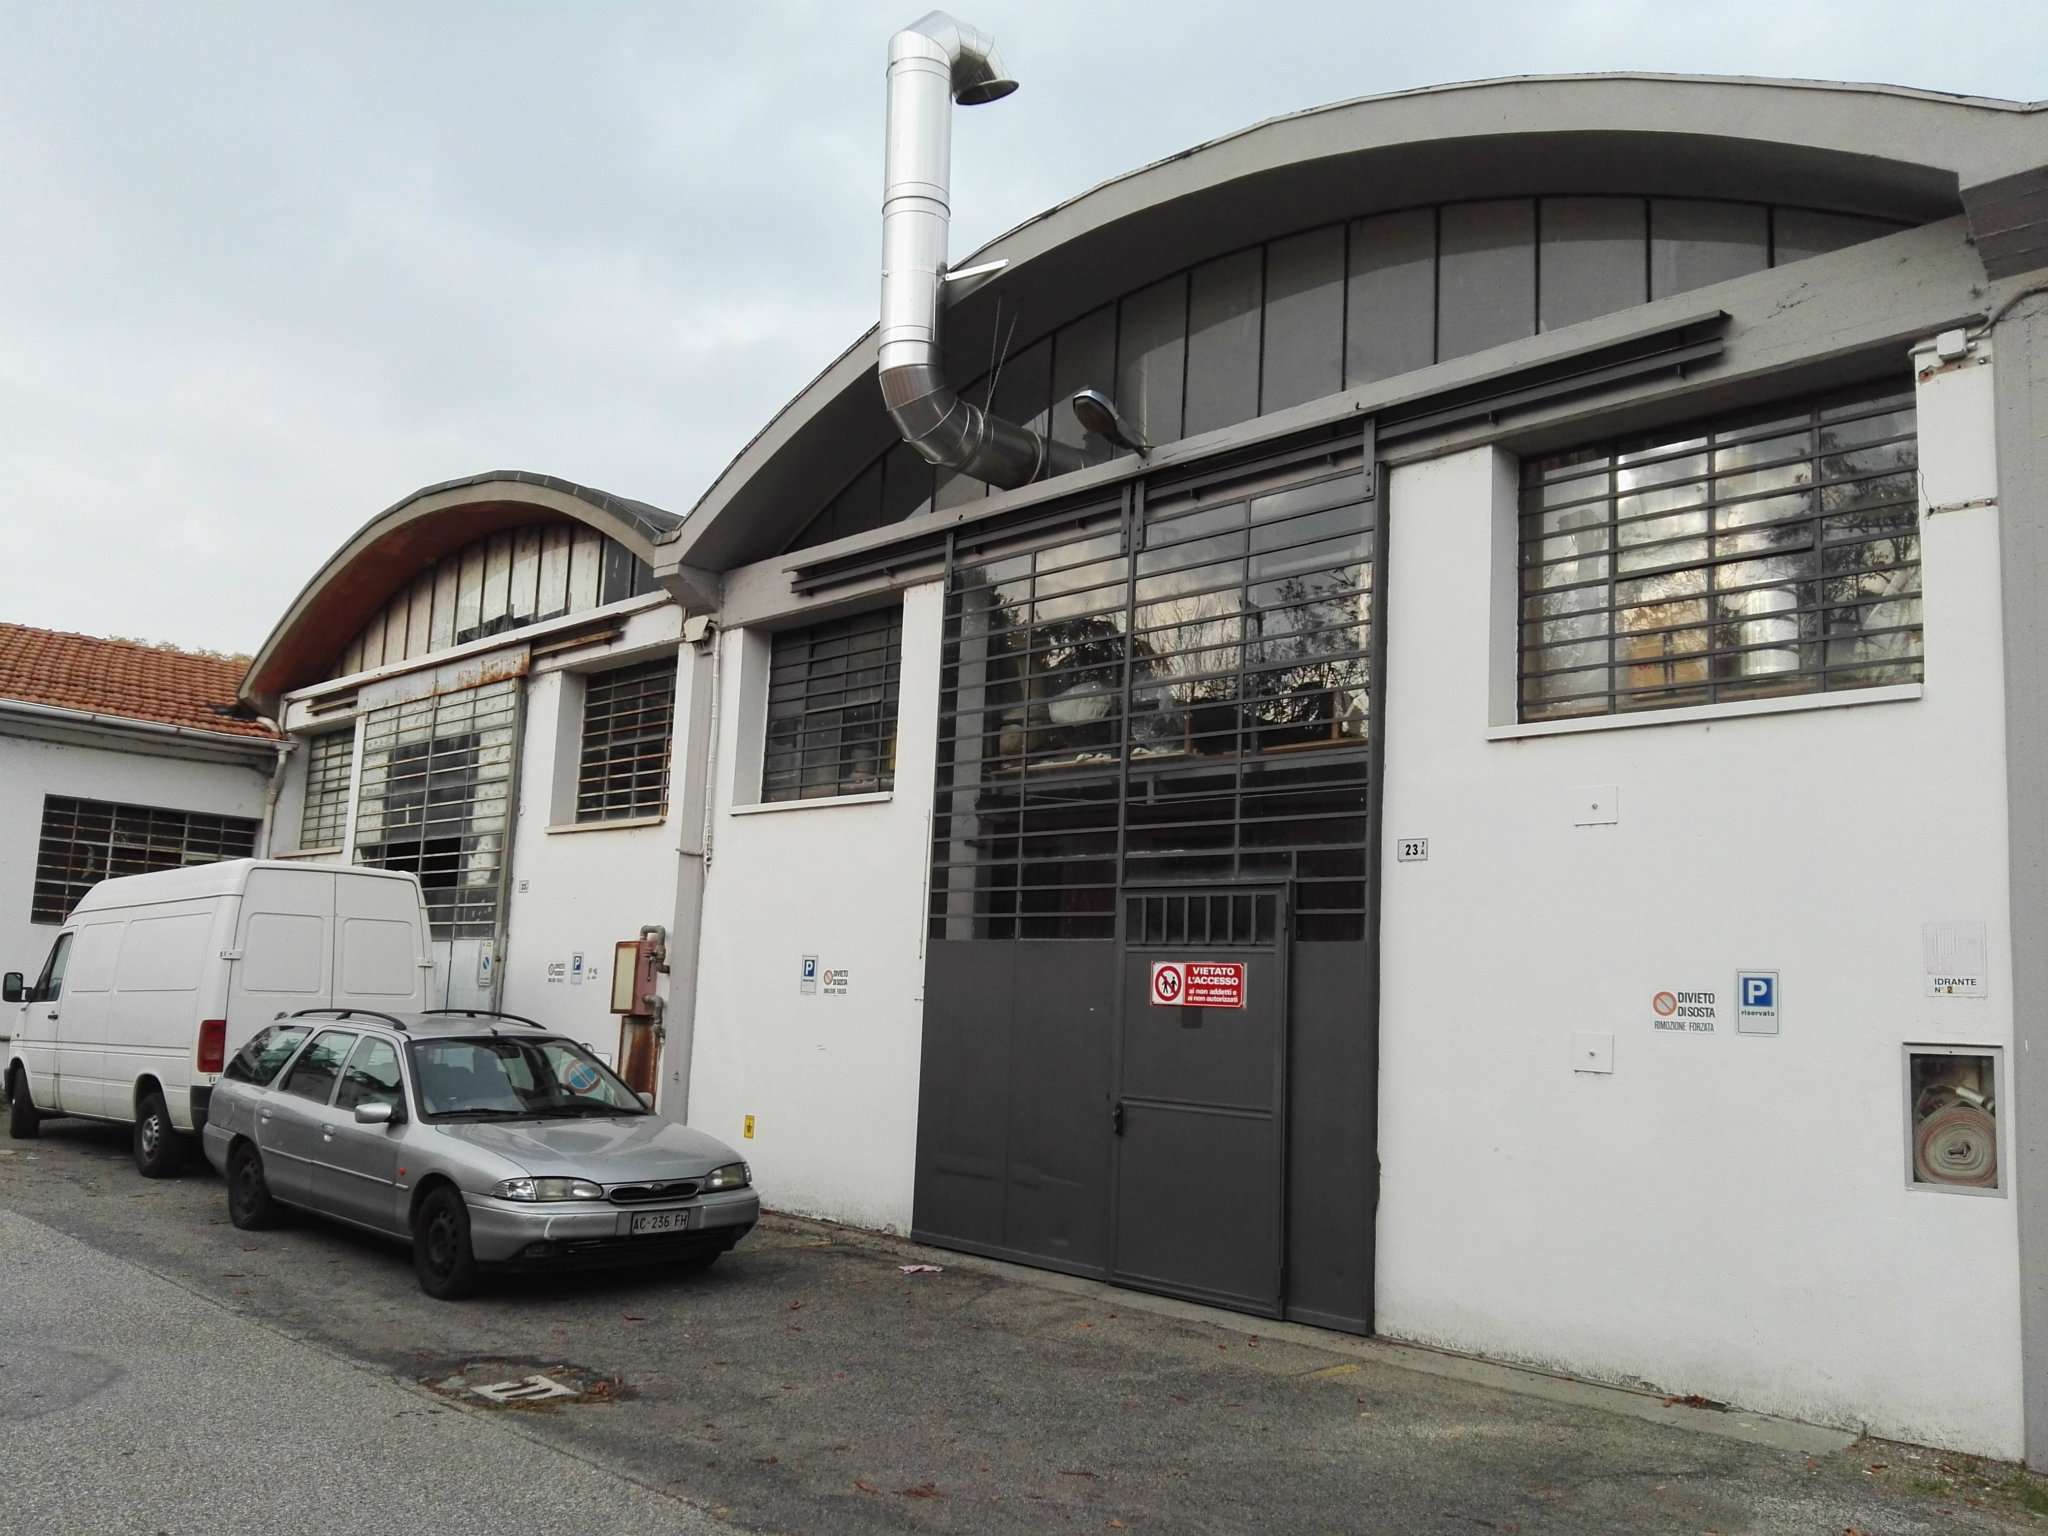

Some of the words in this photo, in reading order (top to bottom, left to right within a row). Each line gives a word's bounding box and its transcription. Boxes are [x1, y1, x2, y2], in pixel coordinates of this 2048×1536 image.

[1405, 843, 1418, 856] 23
[806, 961, 813, 975] P
[1192, 967, 1235, 976] VIETATO
[1187, 976, 1239, 985] L'ACCESSO
[1934, 978, 1977, 986] IDRANTE
[1677, 991, 1715, 1004] DIVIETO
[1747, 980, 1768, 1004] P
[1677, 1006, 1687, 1017] DI
[1687, 1007, 1716, 1018] SOSTA
[1654, 1020, 1686, 1031] RIMOZIONE
[1689, 1021, 1715, 1032] FORZATA
[675, 1214, 688, 1227] FH
